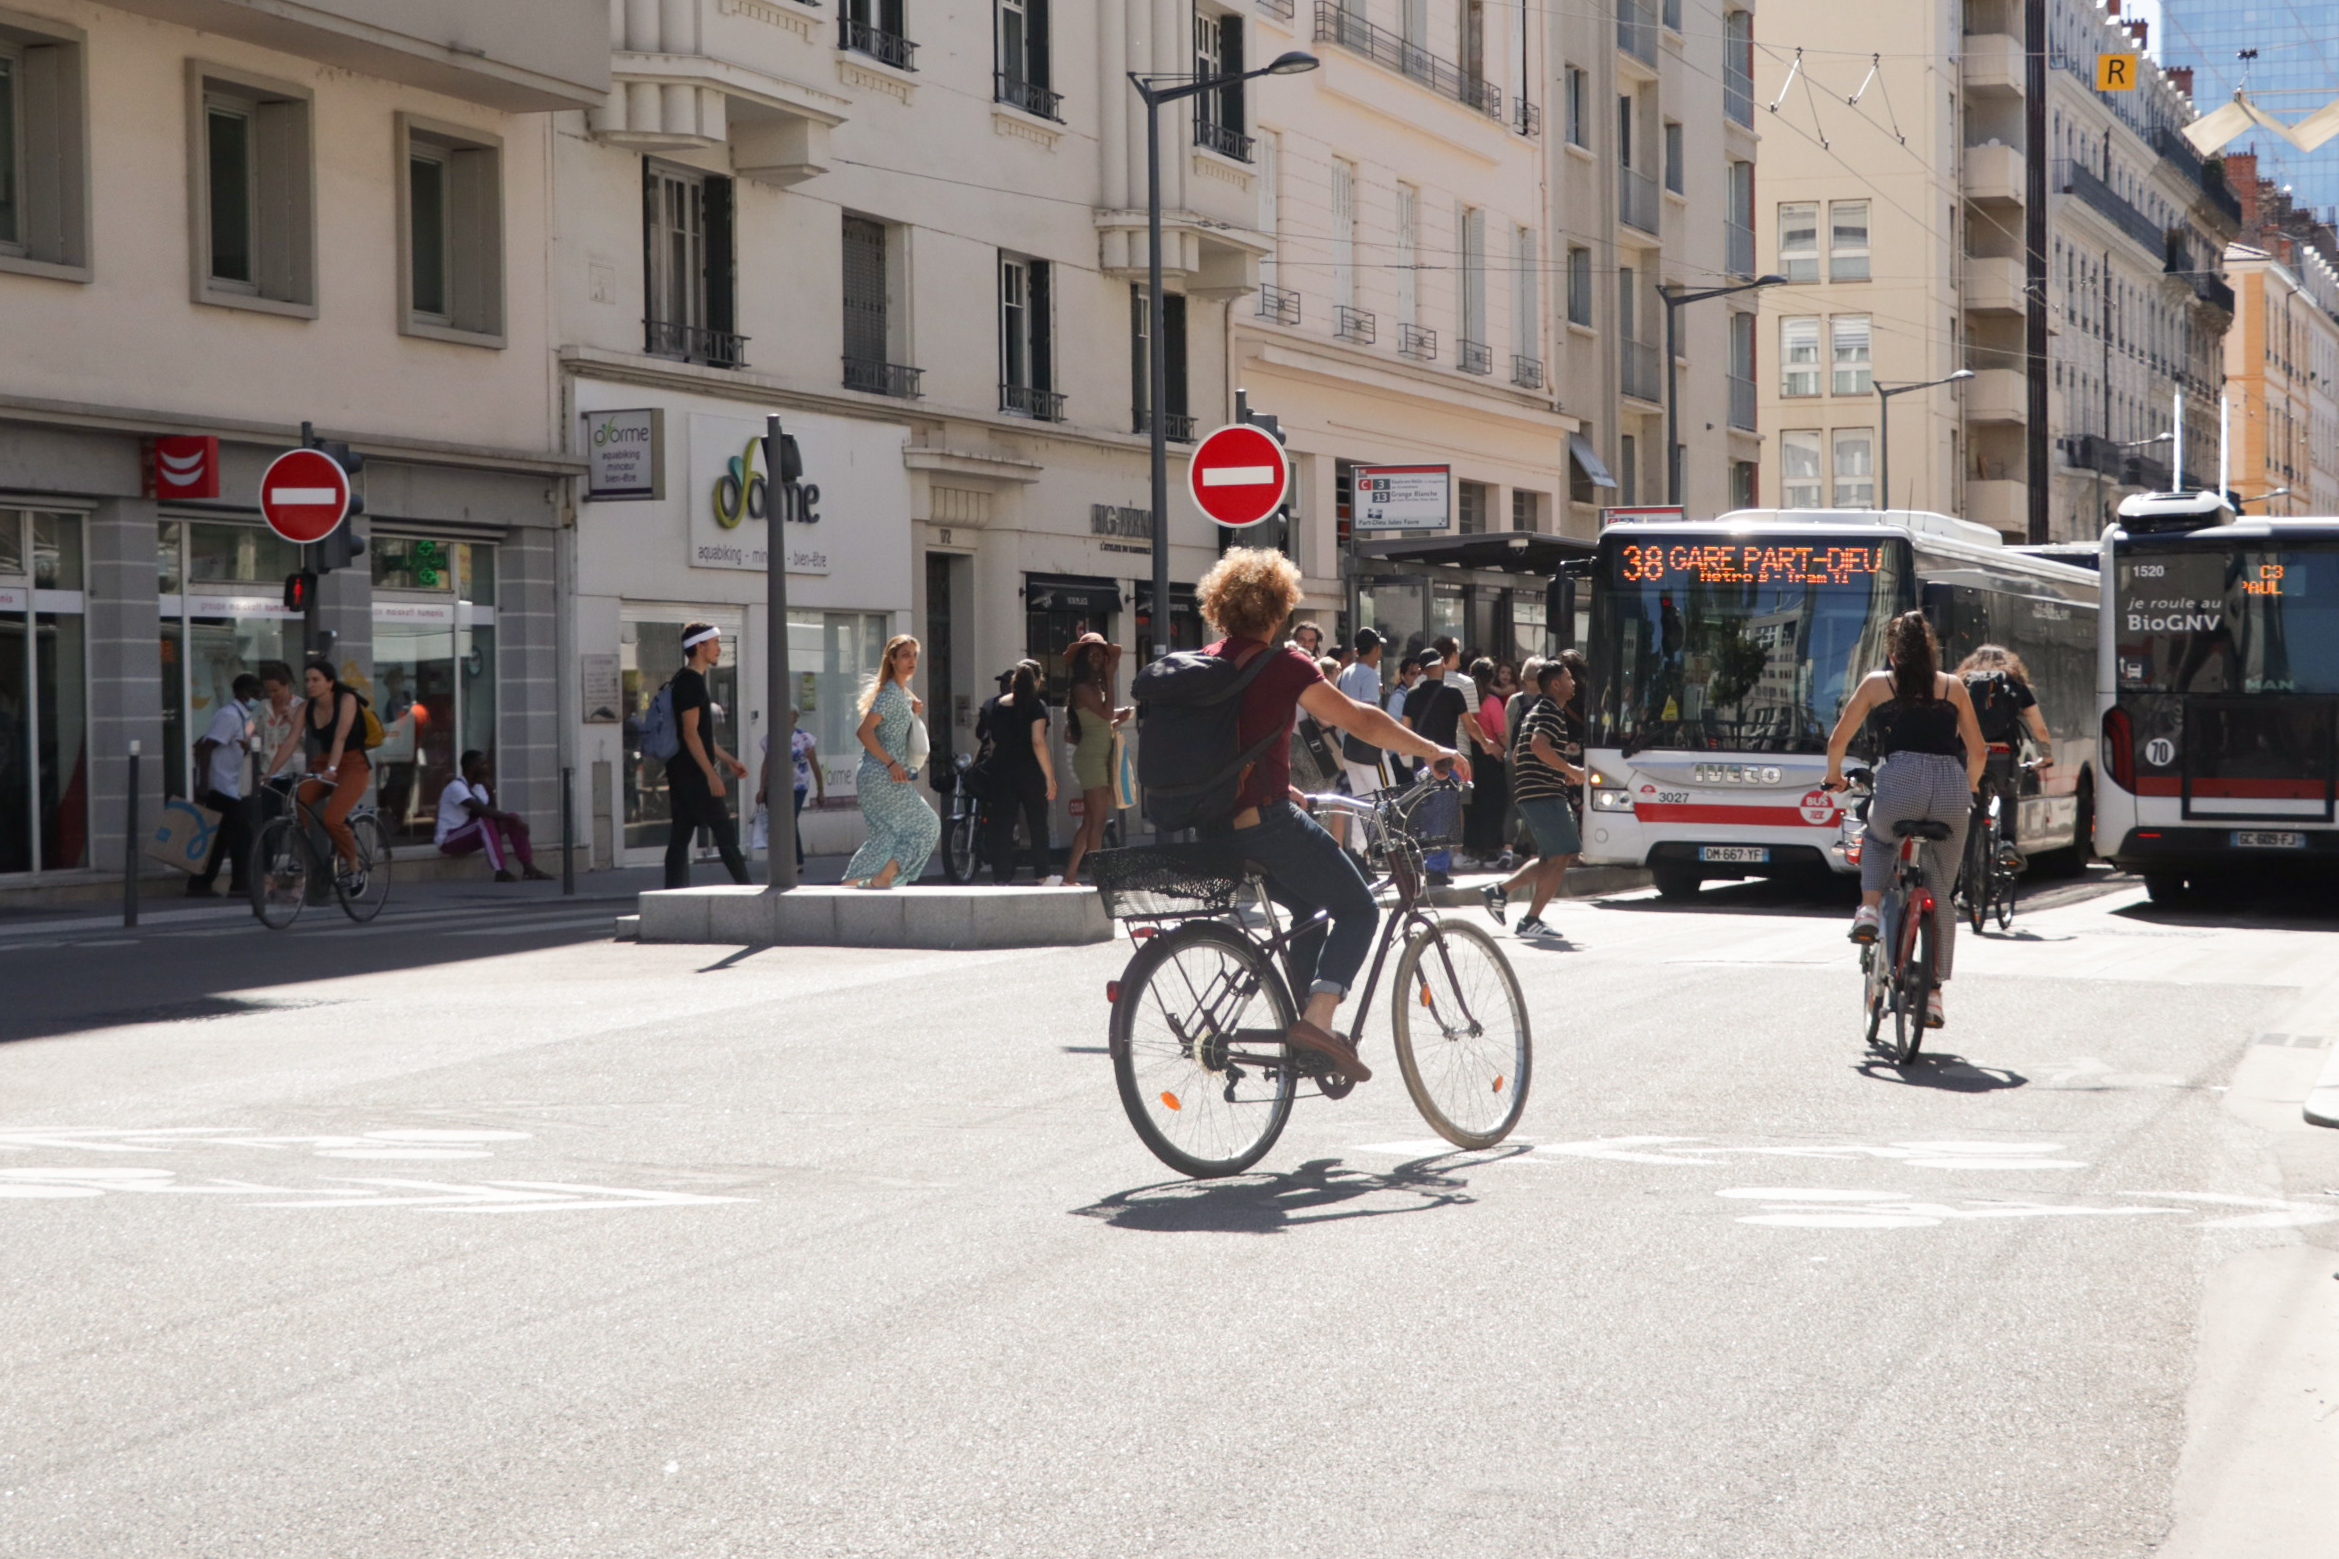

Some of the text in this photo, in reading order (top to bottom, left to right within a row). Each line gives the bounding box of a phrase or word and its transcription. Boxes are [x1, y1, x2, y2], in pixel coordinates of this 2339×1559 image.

[2107, 59, 2125, 84] R
[602, 450, 640, 460] aquabiking
[1375, 493, 1388, 502] 13
[698, 544, 742, 565] aquabiking
[794, 551, 827, 567] bien-être
[1623, 545, 1882, 581] 38 GARE PART-DIEU
[1788, 572, 1828, 583] Tram
[2133, 565, 2165, 577] 1520
[2259, 565, 2284, 578] C3
[2127, 597, 2222, 611] je roule au
[2127, 614, 2221, 631] BioGNV
[2245, 679, 2296, 690] MAN
[2152, 741, 2169, 763] 70
[1695, 764, 1782, 785] IVECO
[1659, 792, 1690, 803] 3027
[1806, 796, 1829, 807] BUS
[1706, 848, 1762, 861] DM-667-YF
